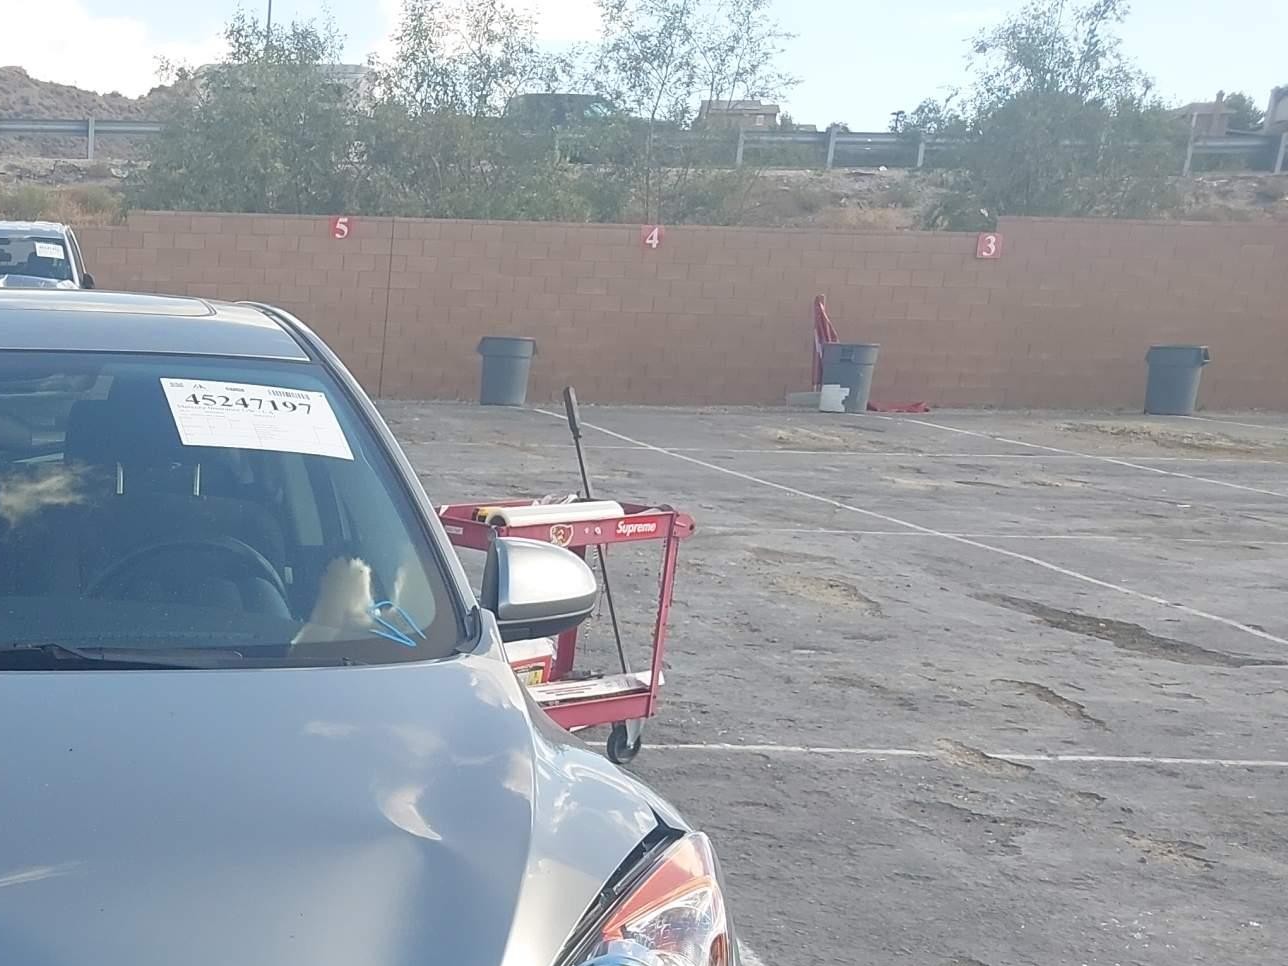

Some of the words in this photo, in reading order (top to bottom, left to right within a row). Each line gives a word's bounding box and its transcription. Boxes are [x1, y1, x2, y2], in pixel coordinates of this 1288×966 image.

[336, 217, 348, 238] 5
[646, 227, 659, 248] 4
[982, 235, 995, 255] 3
[184, 393, 311, 415] 45247197
